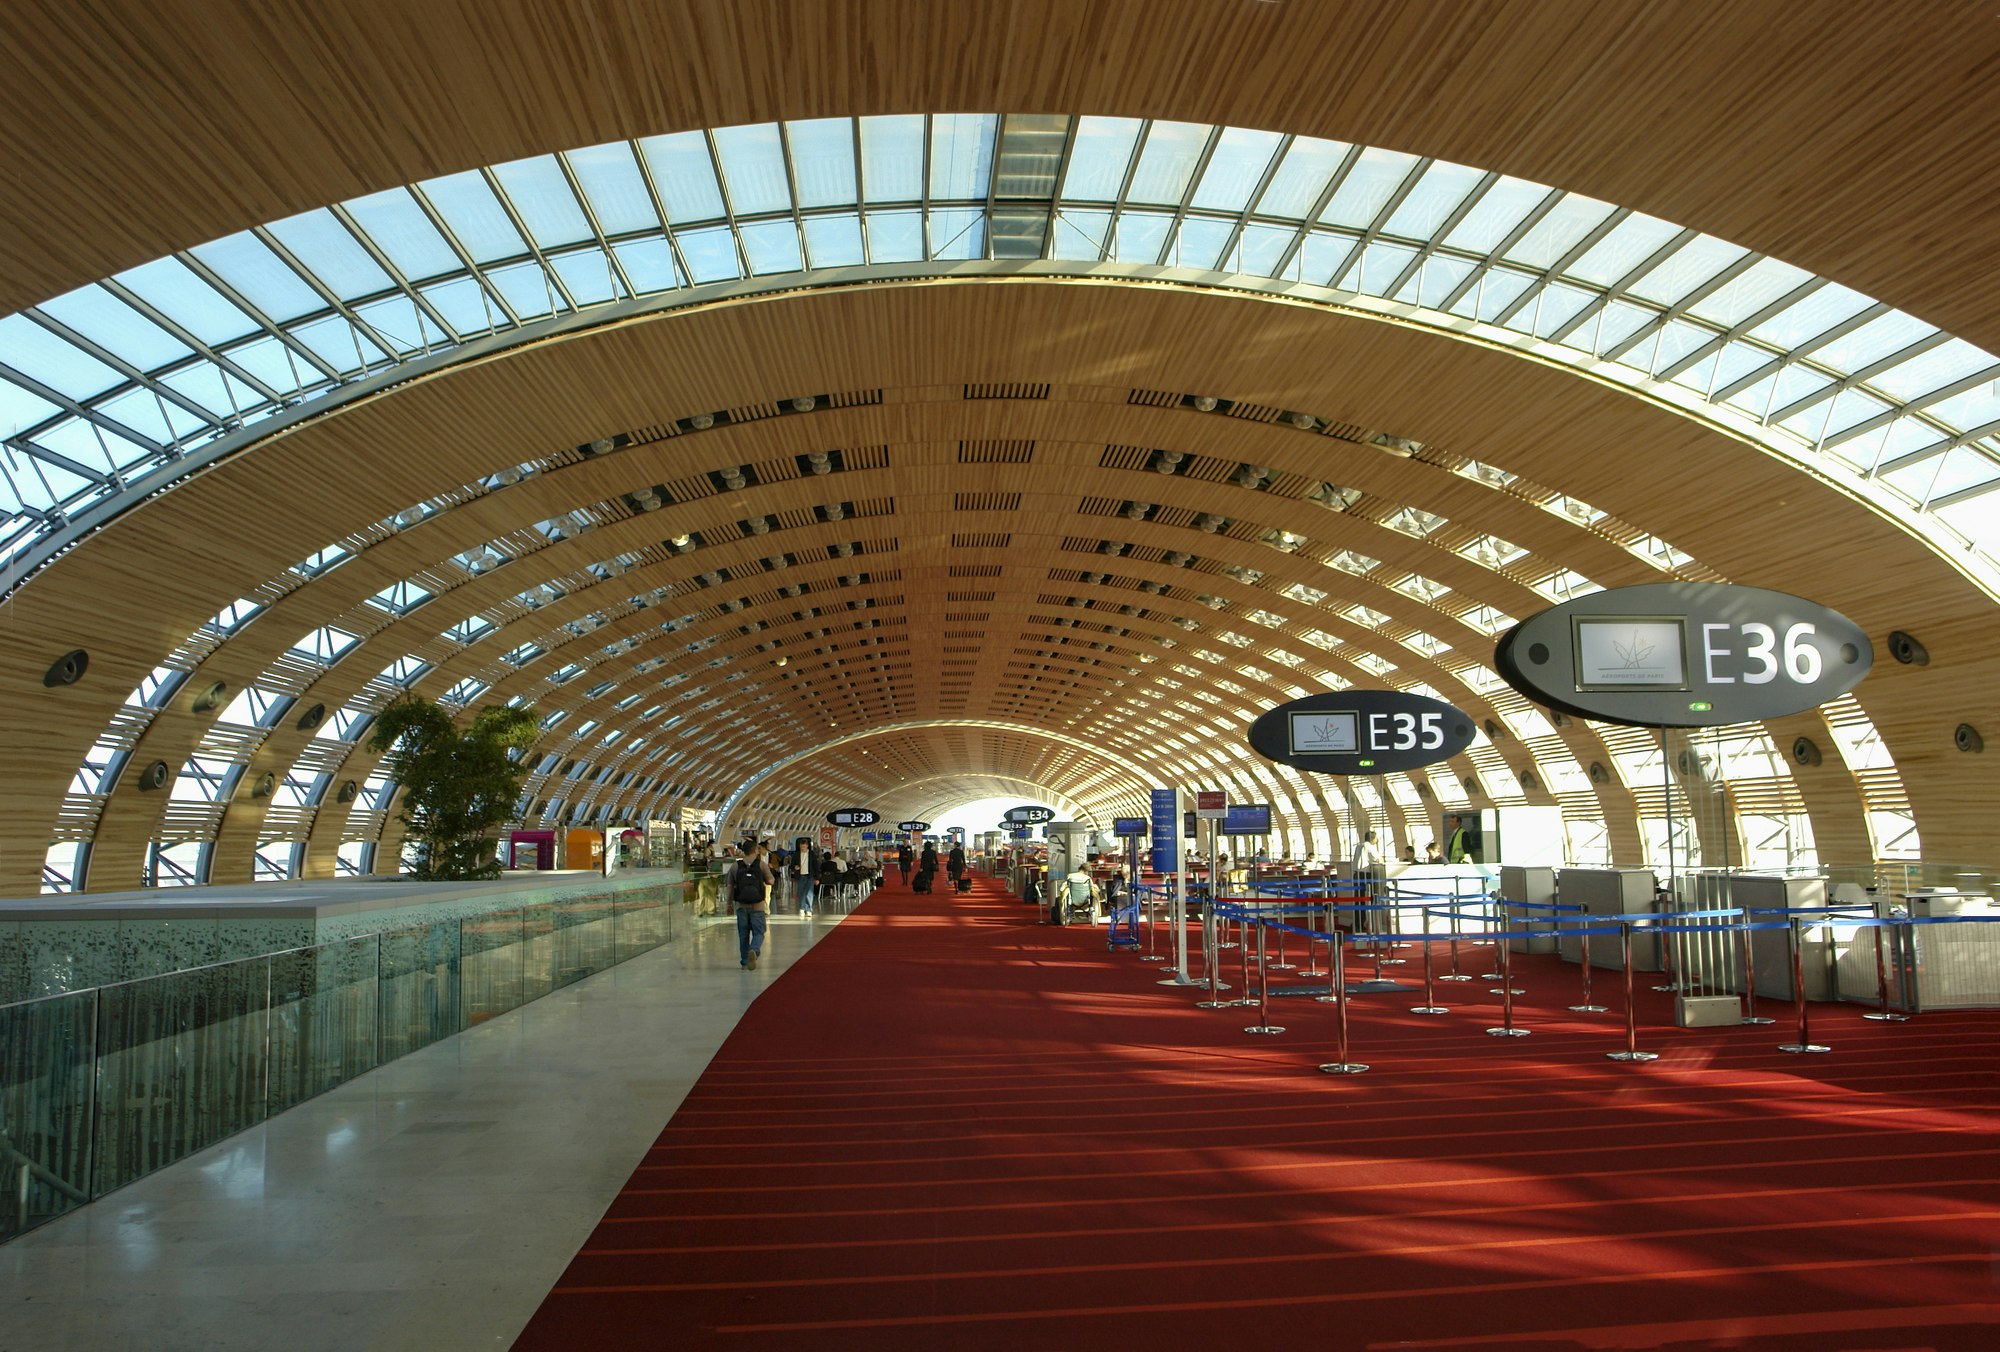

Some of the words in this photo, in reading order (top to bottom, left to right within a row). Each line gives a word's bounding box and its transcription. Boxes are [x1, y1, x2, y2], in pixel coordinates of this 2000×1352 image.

[1702, 622, 1823, 685] E36
[1369, 712, 1445, 751] E35
[853, 812, 873, 823] E28
[1030, 810, 1049, 820] E34
